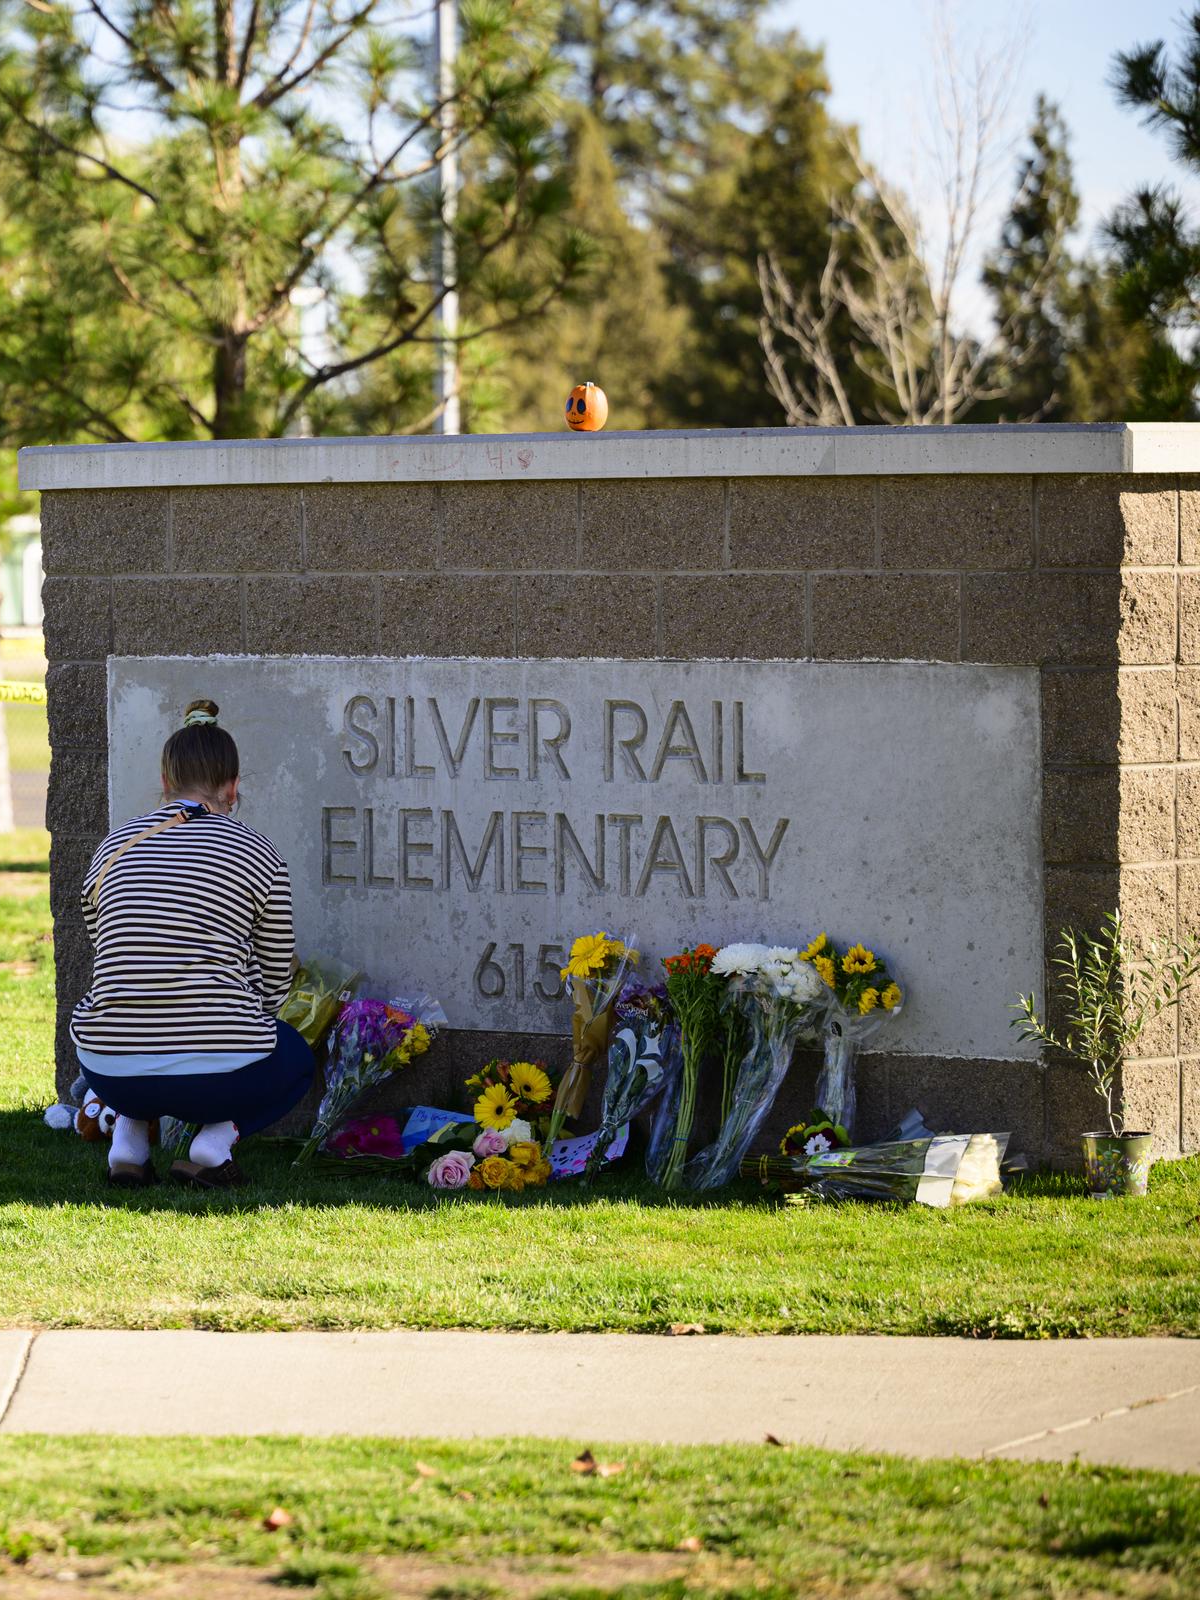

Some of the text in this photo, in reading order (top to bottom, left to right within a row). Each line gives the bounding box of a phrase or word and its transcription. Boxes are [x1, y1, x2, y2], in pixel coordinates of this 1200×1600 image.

[341, 695, 767, 786] SILVER RAIL
[321, 807, 790, 901] ELEMENTARY
